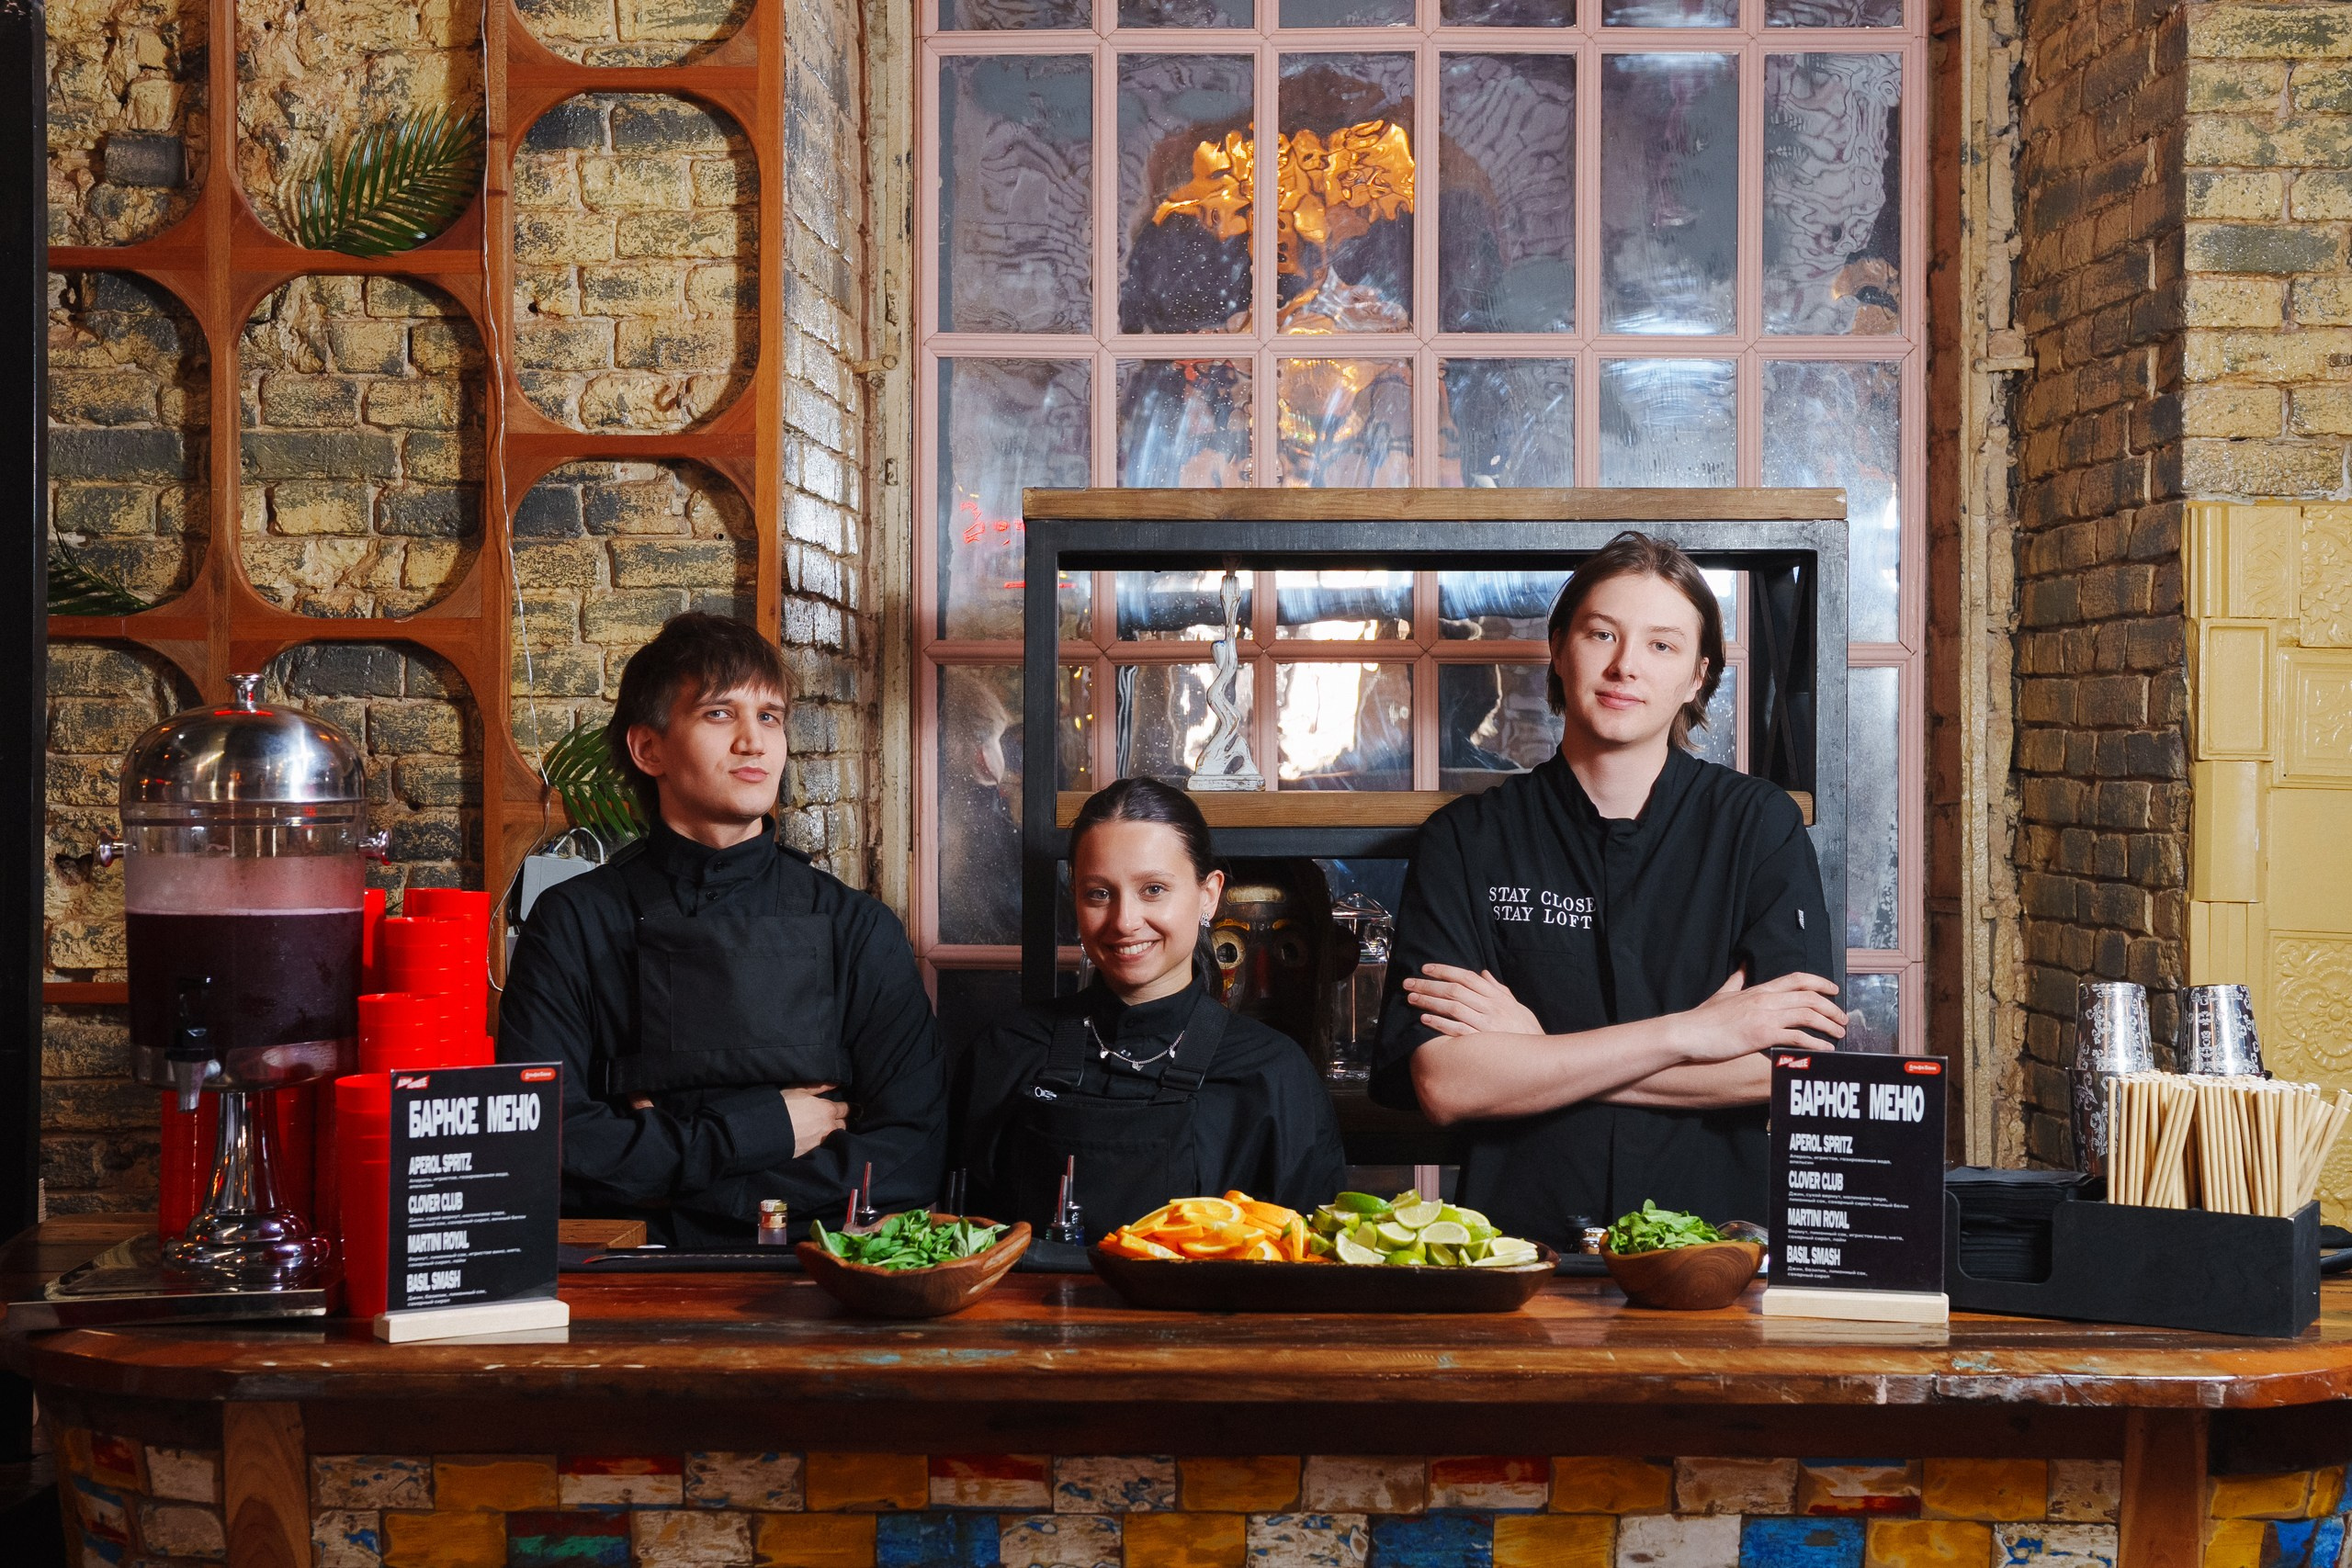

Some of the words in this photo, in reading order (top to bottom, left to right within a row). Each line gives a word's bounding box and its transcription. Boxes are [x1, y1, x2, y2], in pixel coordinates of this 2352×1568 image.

[1488, 886, 1531, 903] STAY
[1541, 891, 1596, 913] CLOSE
[1493, 905, 1533, 921] STAY
[1544, 909, 1592, 930] LOFT
[1790, 1079, 1860, 1120] БАРНОЕ
[1869, 1082, 1925, 1122] МЕНЮ
[409, 1096, 479, 1139] БАРНОЕ
[486, 1092, 540, 1134] МЕНЮ
[1789, 1133, 1822, 1152] APEROL
[1823, 1134, 1853, 1154] SPRITZ
[408, 1156, 441, 1176] APEROL
[442, 1153, 472, 1173] SPRITZ
[1788, 1170, 1821, 1190] CLOVER
[1822, 1172, 1844, 1191] CLUB
[408, 1193, 441, 1214] CLOVER
[441, 1191, 464, 1213] CLUB
[1787, 1207, 1822, 1227] MARTINI
[1823, 1210, 1849, 1229] ROYAL
[407, 1232, 442, 1254] MARTINI
[443, 1230, 470, 1250] ROYAL
[1786, 1245, 1811, 1264] BASIL
[1812, 1247, 1841, 1266] SMASH
[406, 1271, 432, 1293] BASIL
[432, 1269, 461, 1291] SMASH
